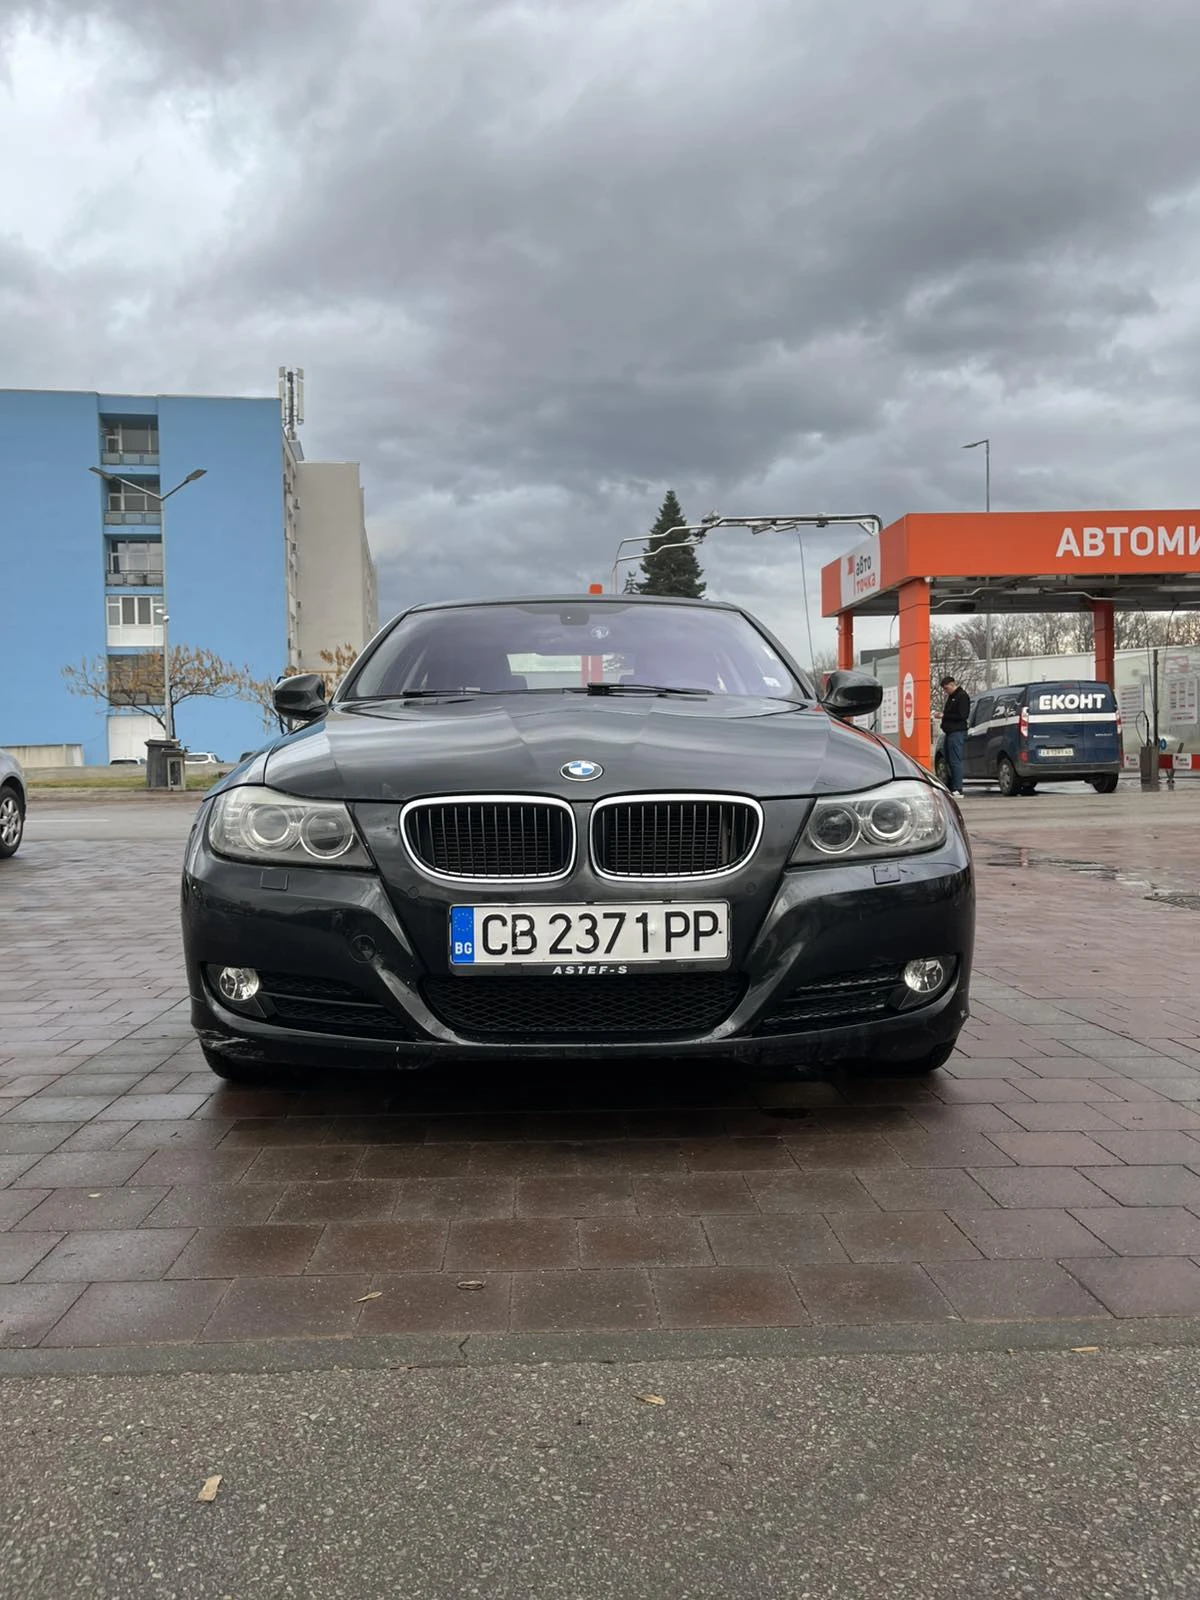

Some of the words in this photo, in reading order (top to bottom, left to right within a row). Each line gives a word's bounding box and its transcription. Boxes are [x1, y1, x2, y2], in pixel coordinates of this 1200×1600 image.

[1039, 693, 1106, 710] ЕКОНТ
[482, 914, 538, 956] CB
[549, 912, 649, 955] 2371
[665, 910, 719, 953] PP
[455, 942, 472, 954] BG
[552, 965, 628, 975] ASTEF-S
